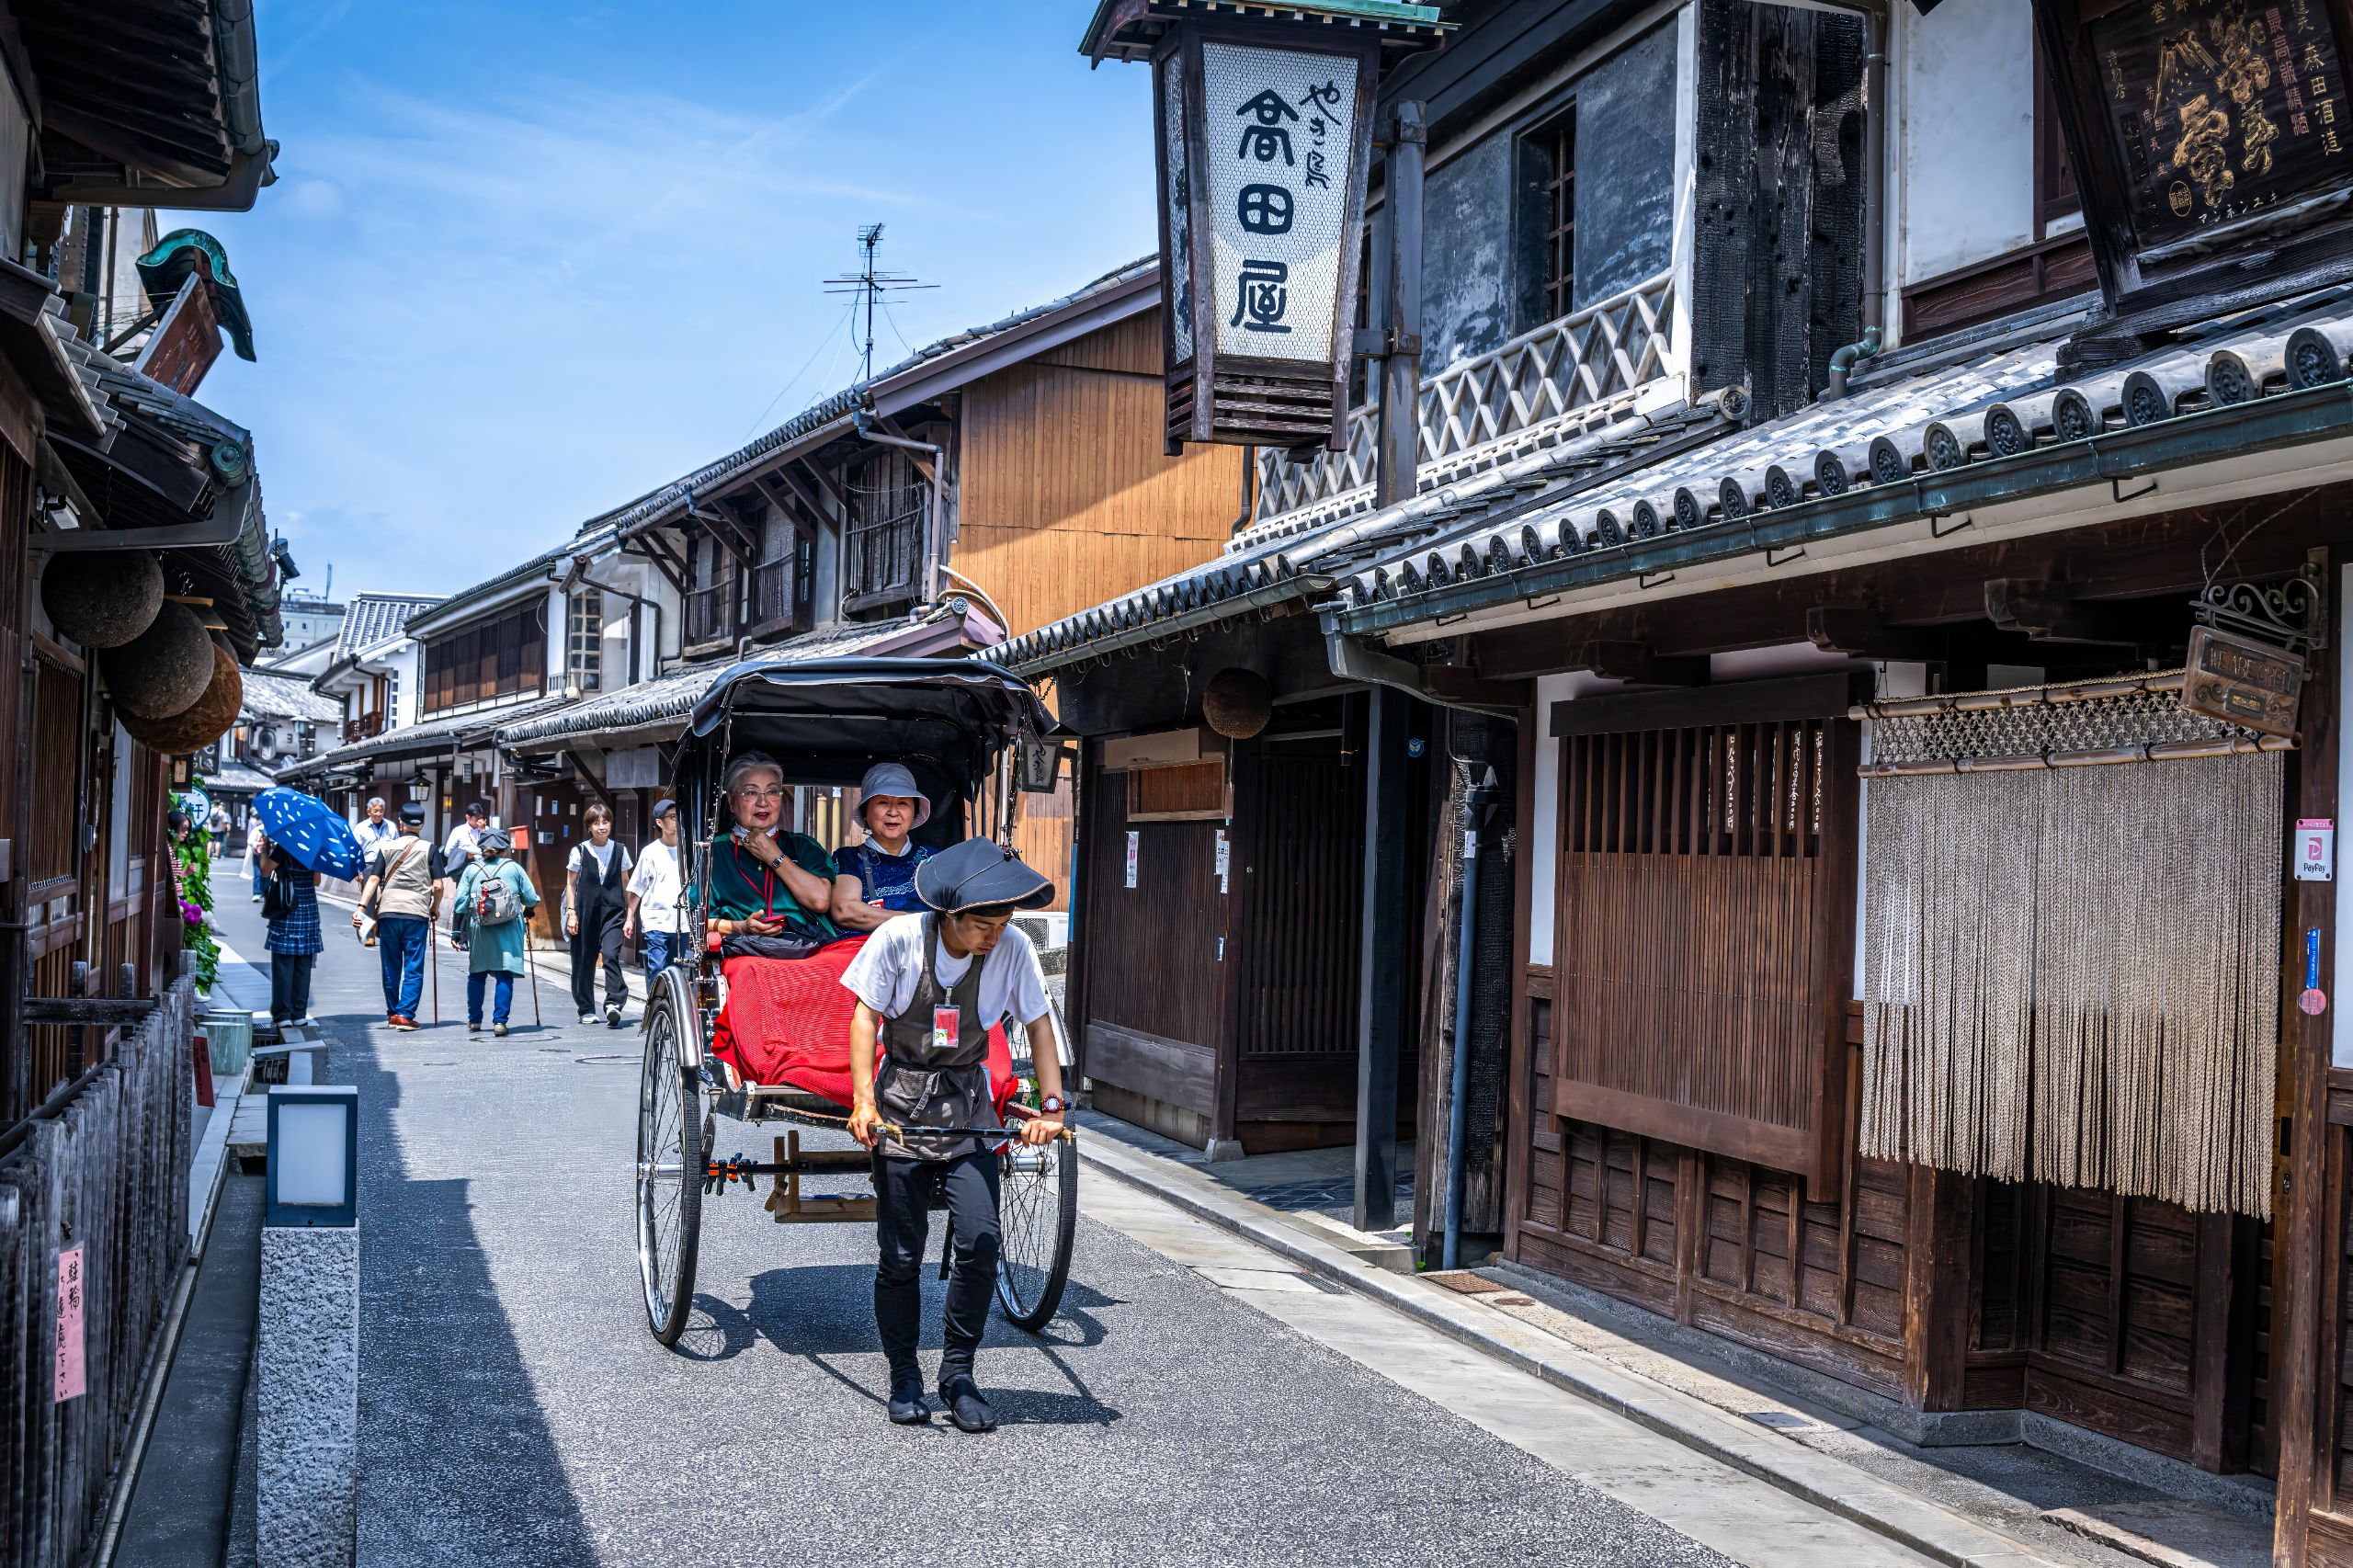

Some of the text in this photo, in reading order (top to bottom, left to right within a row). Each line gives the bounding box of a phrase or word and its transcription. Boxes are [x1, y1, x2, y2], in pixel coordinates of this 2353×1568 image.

[2303, 44, 2343, 157] 森田酒造
[2303, 862, 2326, 874] PayPay
